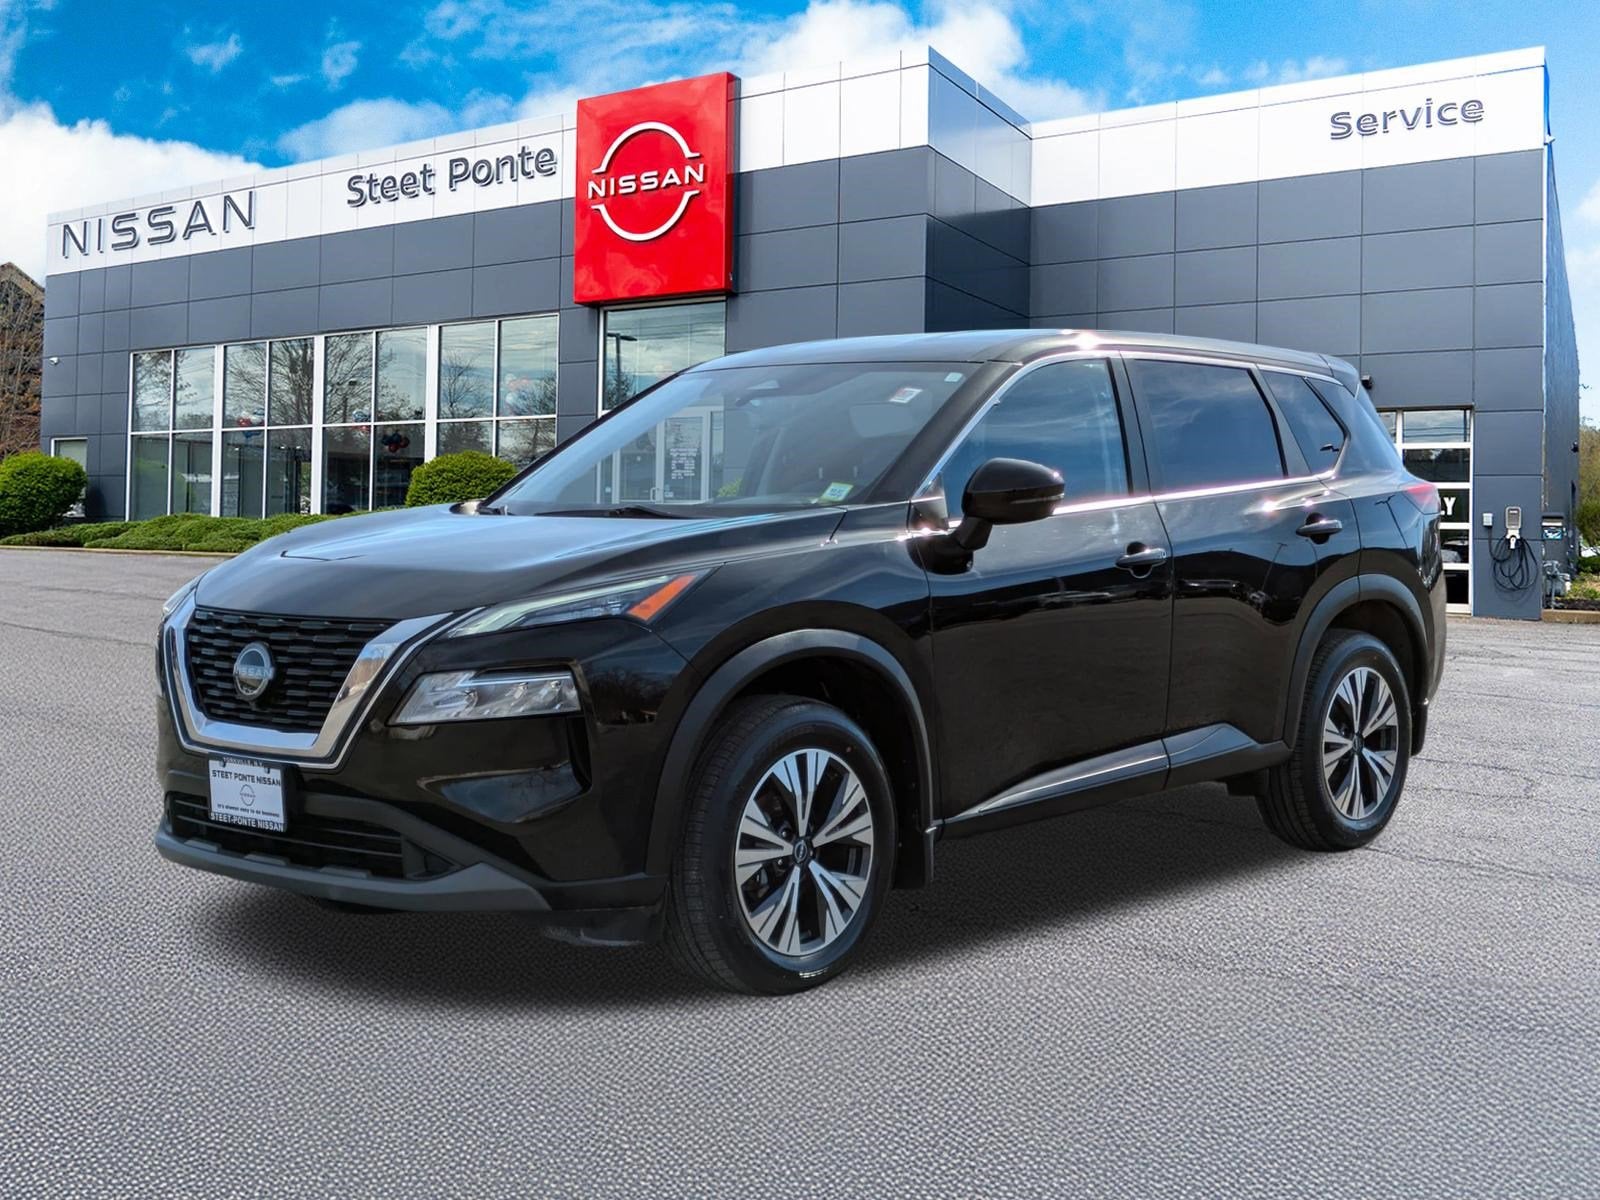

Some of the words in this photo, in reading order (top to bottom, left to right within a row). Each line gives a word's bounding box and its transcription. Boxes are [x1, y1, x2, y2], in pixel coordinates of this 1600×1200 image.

[1330, 98, 1485, 140] Service
[347, 163, 436, 207] Steet
[449, 145, 558, 191] Ponte
[587, 163, 705, 199] NISSAN
[62, 191, 255, 259] NISSAN
[212, 770, 232, 779] STEET
[234, 773, 255, 783] PONTE
[256, 777, 281, 786] NISSAN
[257, 820, 284, 832] NISSAN
